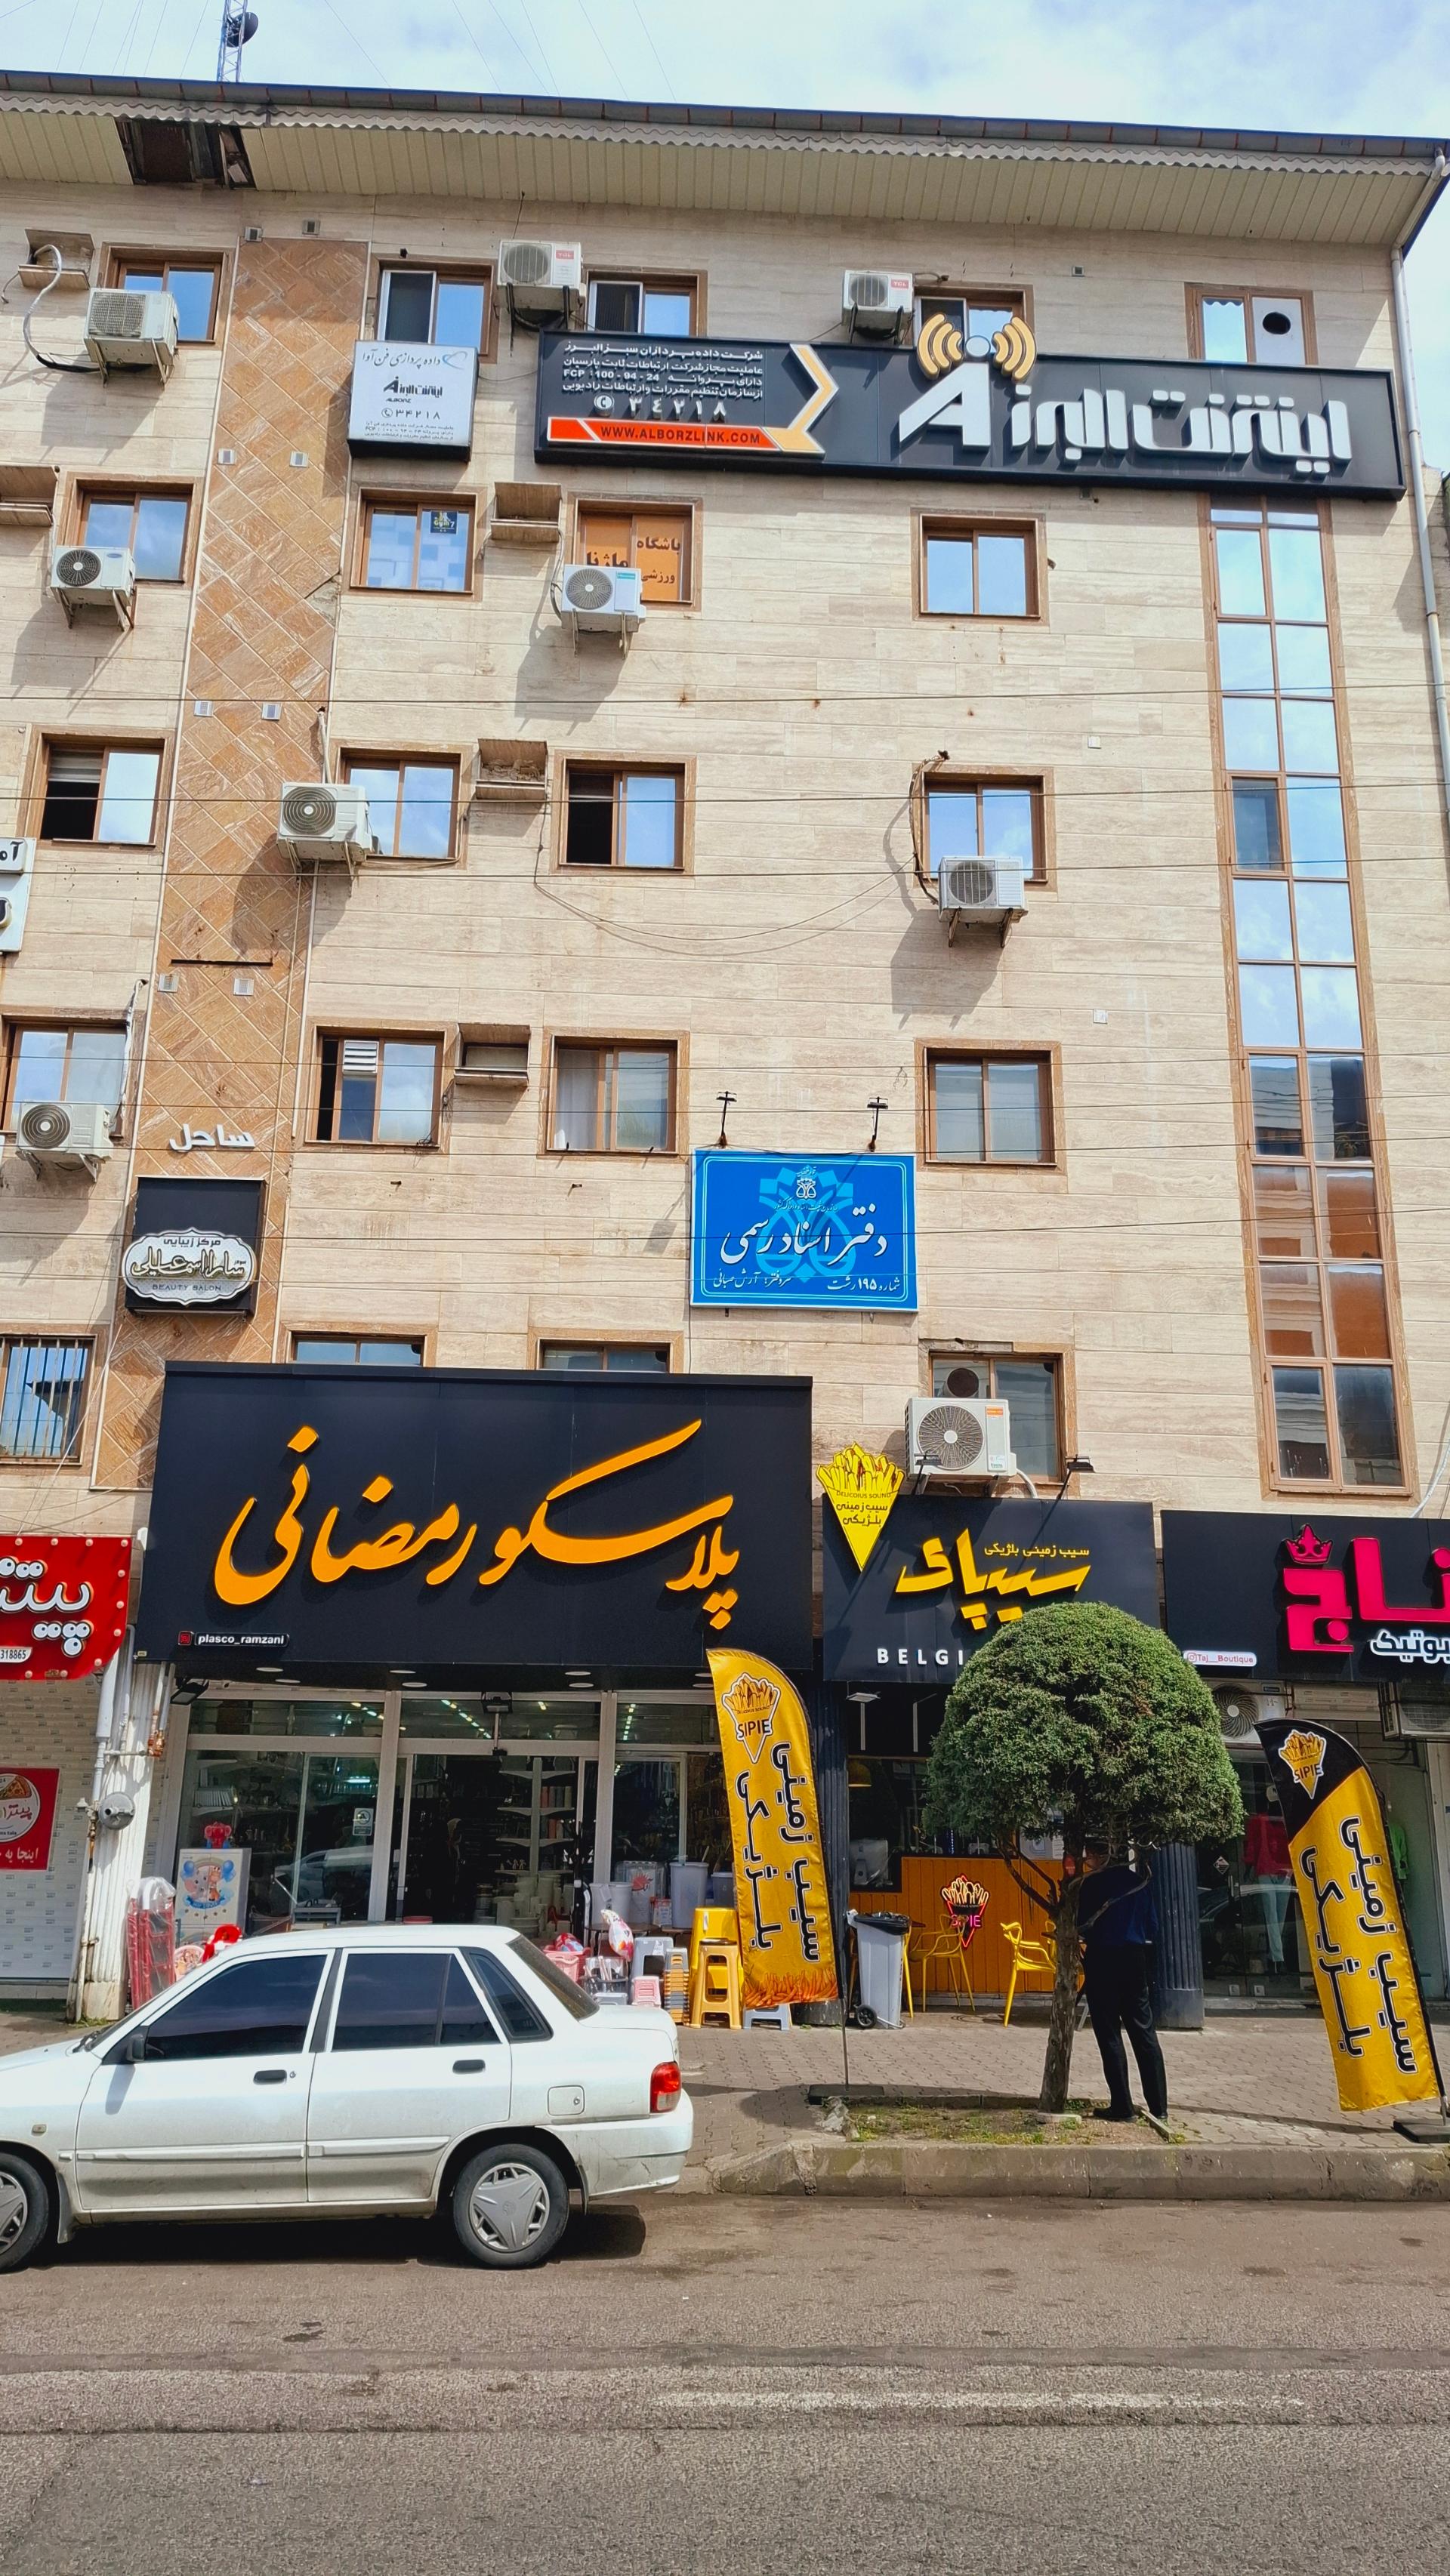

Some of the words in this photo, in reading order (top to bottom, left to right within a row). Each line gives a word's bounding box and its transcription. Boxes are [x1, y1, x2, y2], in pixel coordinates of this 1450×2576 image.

[564, 340, 603, 354] البرز
[603, 344, 638, 356] سبز
[696, 349, 720, 357] داده
[362, 349, 378, 362] آوا
[373, 348, 389, 367] فن
[389, 352, 421, 368] پردازی
[423, 356, 441, 366] داده
[563, 357, 600, 369] پارسیان
[721, 350, 763, 361] شرکت
[601, 359, 625, 369] ثابت
[626, 360, 669, 371] ارتباطات
[671, 362, 704, 372] شرکت
[727, 365, 763, 376] عاملیت
[563, 369, 585, 377] FCP
[652, 384, 690, 395] مقررات
[736, 377, 763, 387] دارای
[690, 386, 719, 398] تنظیم
[396, 408, 440, 420] ۳۴۲۱۸
[1010, 384, 1129, 461] البرز
[600, 426, 760, 444] WWW.ALBORZLINK.COM
[1131, 389, 1353, 476] اینترنت
[636, 536, 681, 555] باشگاه
[640, 569, 676, 584] ورزشی
[168, 1123, 256, 1153] ساحل
[720, 1218, 774, 1265] رسمی
[778, 1220, 831, 1255] اسناد
[827, 1202, 888, 1266] دفتر
[163, 1237, 194, 1248] زیبایی
[196, 1237, 221, 1248] مرکز
[734, 1268, 762, 1288] آرش
[827, 1275, 856, 1290] رشت
[857, 1277, 878, 1291] ۱۹۵
[878, 1276, 901, 1292] شماره
[836, 1501, 865, 1513] زمینی
[865, 1504, 888, 1513] سیب
[214, 1425, 478, 1606] رمضانی
[842, 1514, 881, 1527] بلژیکی
[478, 1418, 741, 1631] پلاسکو
[984, 1542, 1020, 1558] بلژیکی
[1023, 1542, 1057, 1558] زمینی
[1059, 1544, 1090, 1558] سیب
[198, 1634, 285, 1645] plasco_ramzani
[877, 1647, 964, 1665] BELGI
[737, 1718, 771, 1738] SIPIE
[1294, 1762, 1323, 1781] SIPIE
[771, 1741, 814, 1843] زمینی
[17, 1847, 39, 1864] اینجا
[1337, 1815, 1398, 1936] زمینی
[785, 1858, 821, 1963] سیب
[1368, 1951, 1418, 2075] سیب
